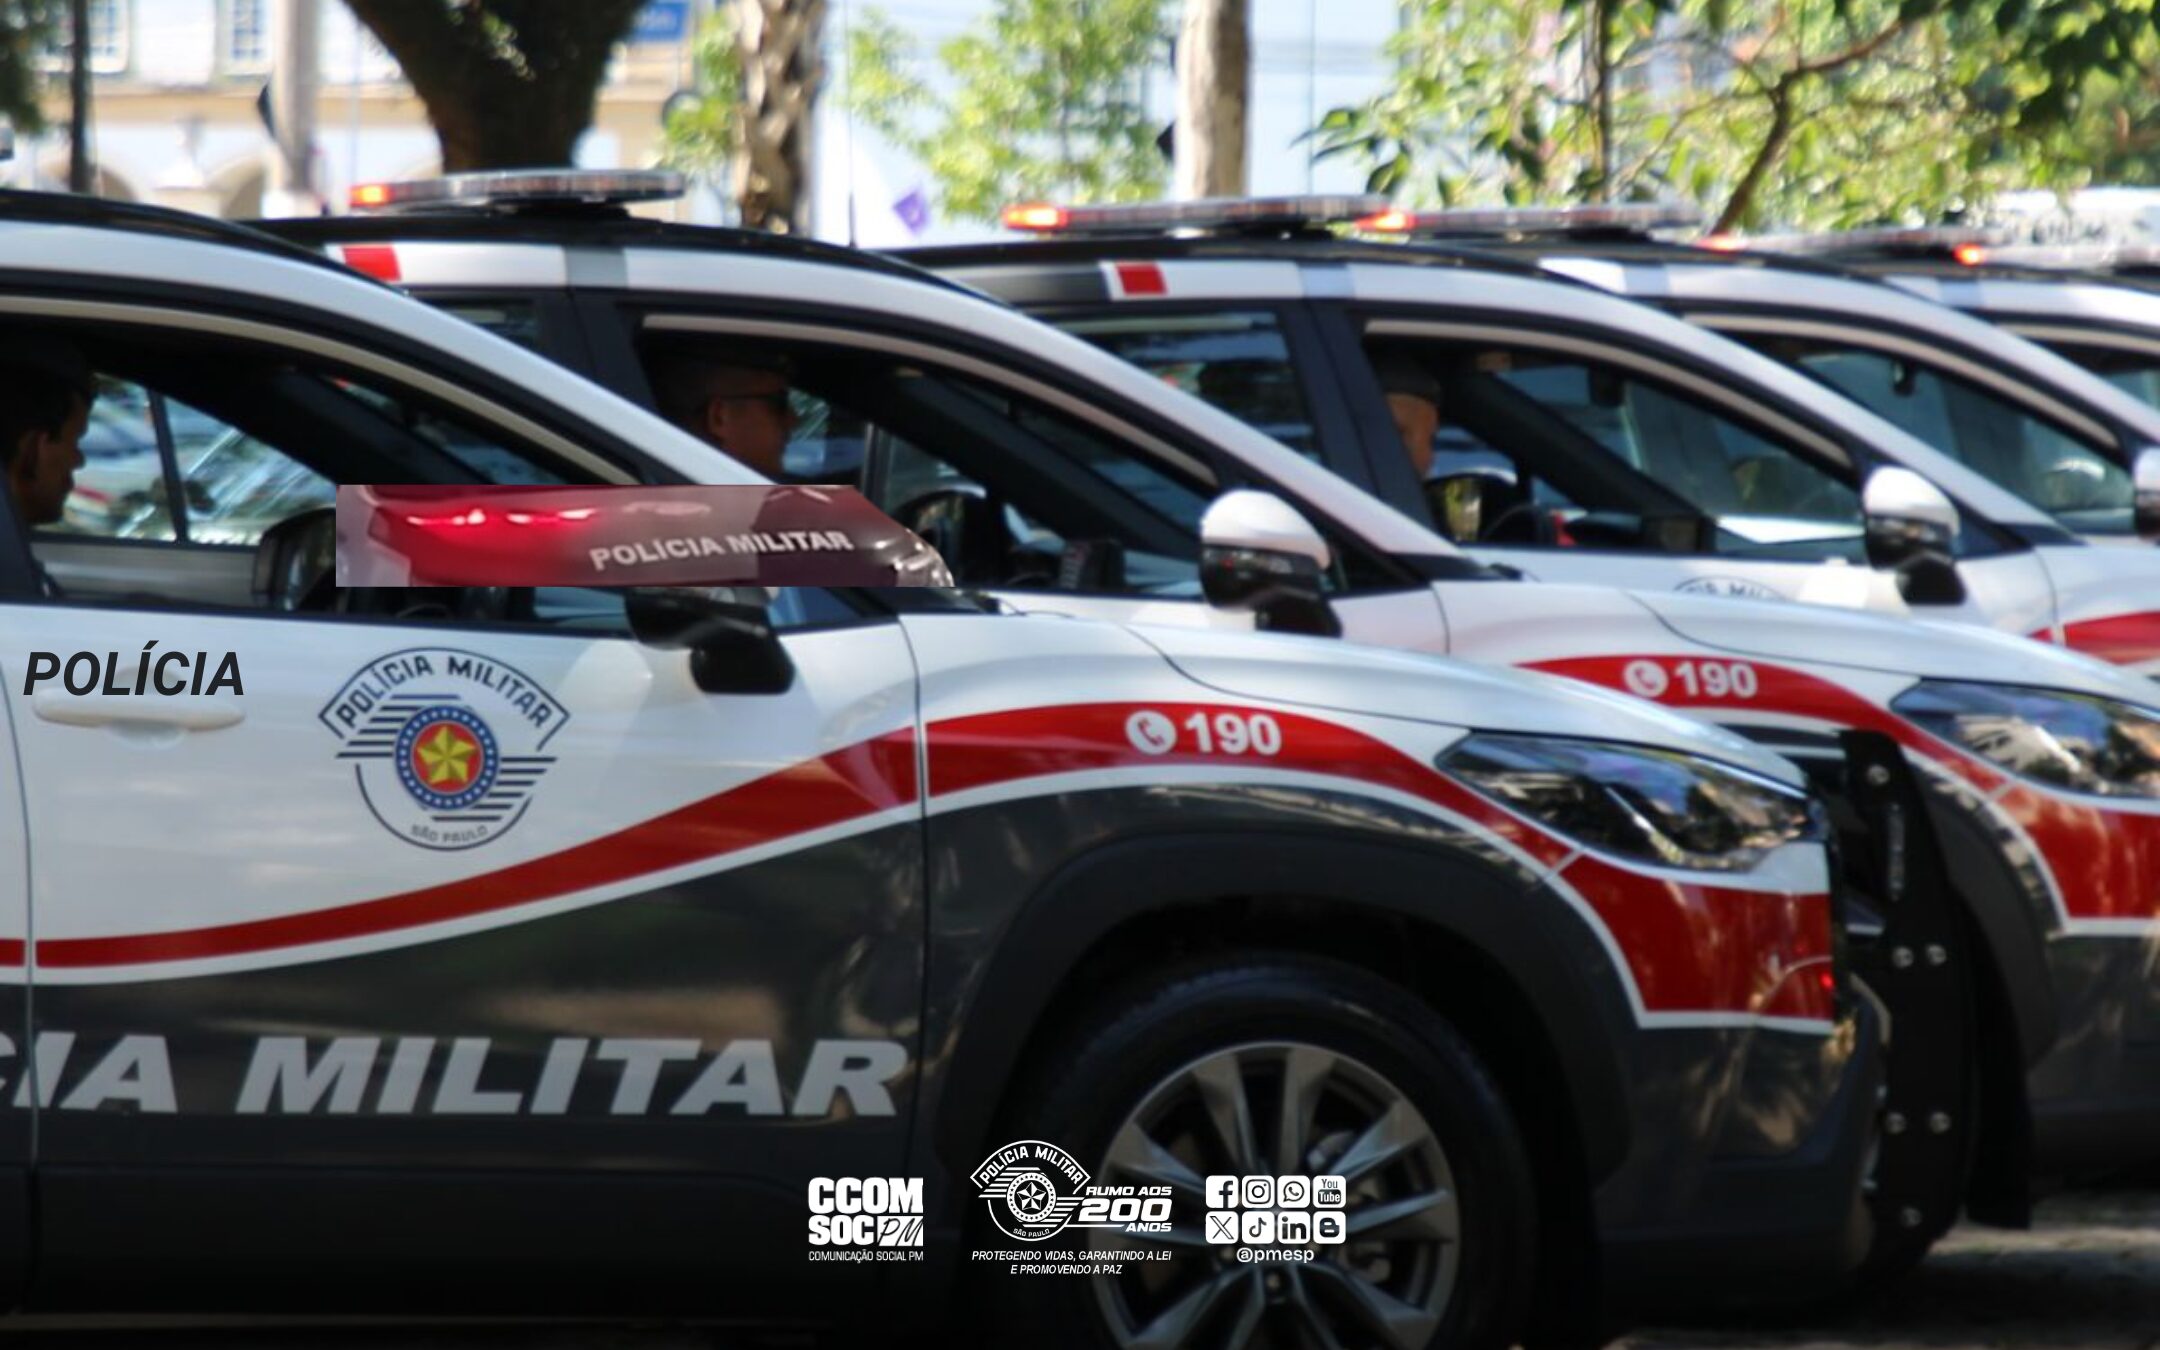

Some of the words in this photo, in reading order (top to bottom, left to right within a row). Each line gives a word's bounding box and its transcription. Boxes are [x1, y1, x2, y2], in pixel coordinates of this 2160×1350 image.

[724, 530, 855, 554] MILITAR
[336, 655, 434, 728] POLÍCIA
[447, 656, 553, 728] MILITAR
[1674, 660, 1758, 698] 190
[1185, 712, 1282, 755] 190
[411, 824, 438, 842] SÃO
[442, 825, 488, 843] PAULO
[236, 1036, 908, 1115] MILITAR
